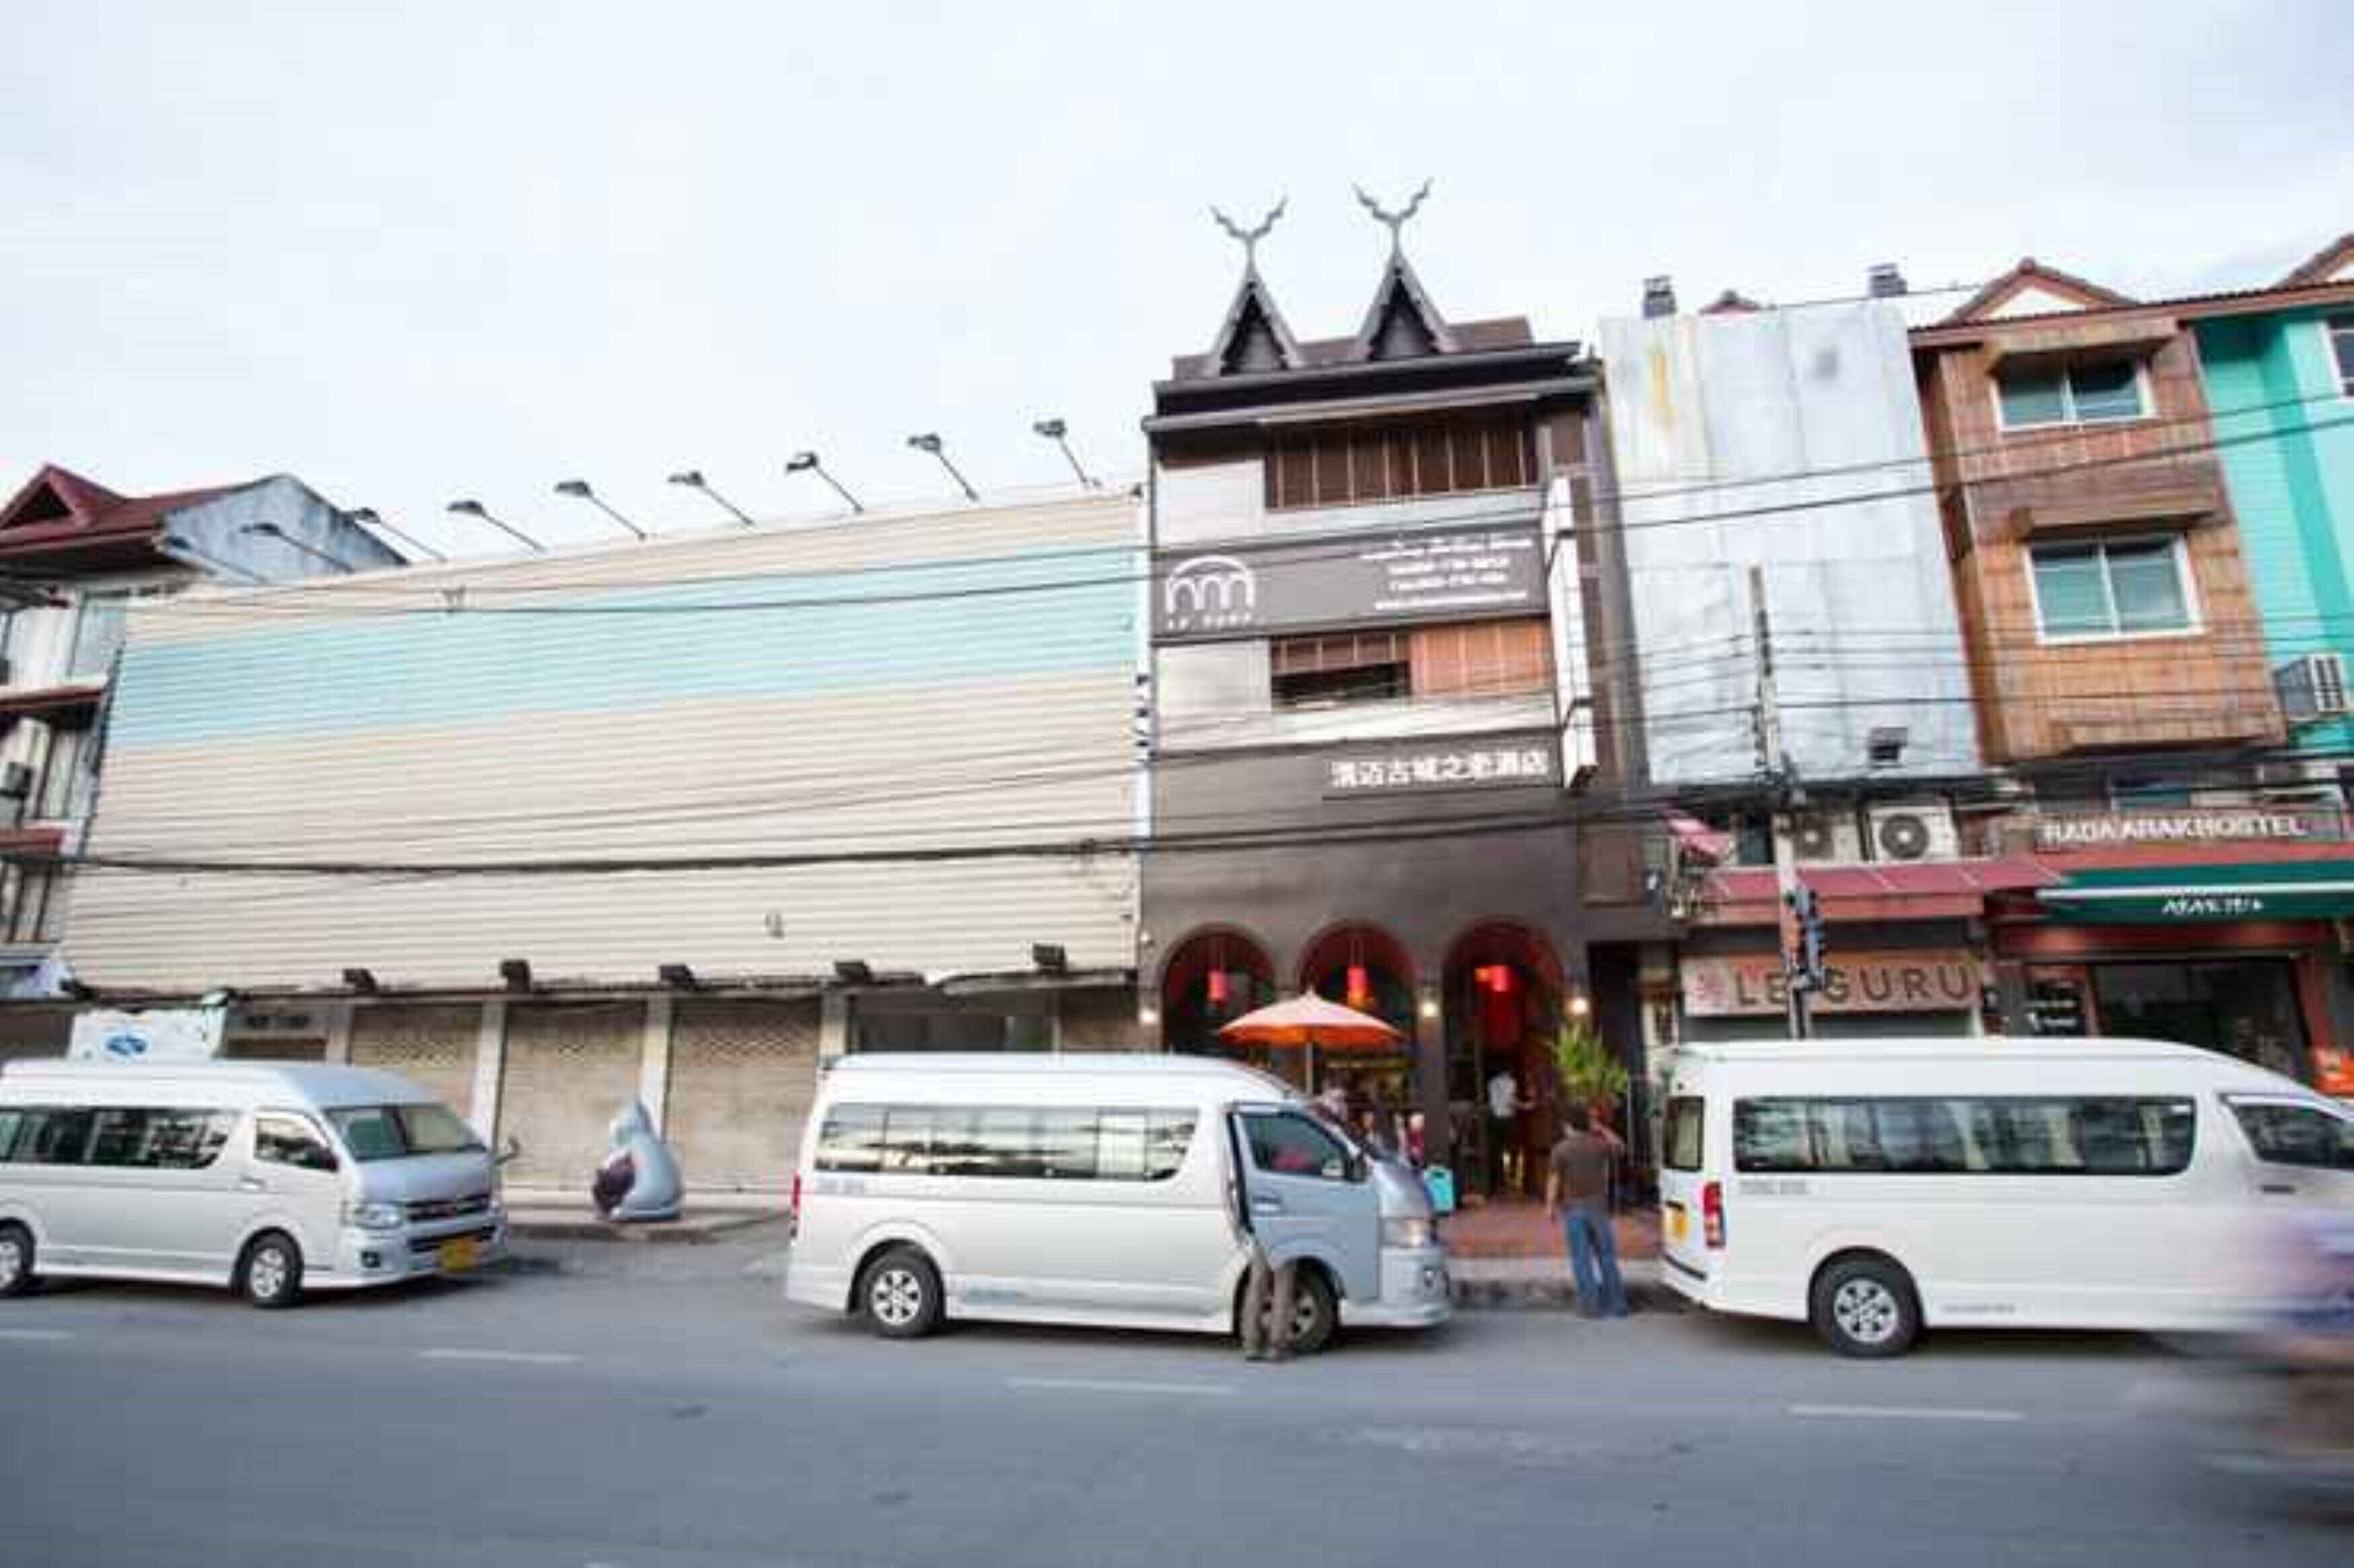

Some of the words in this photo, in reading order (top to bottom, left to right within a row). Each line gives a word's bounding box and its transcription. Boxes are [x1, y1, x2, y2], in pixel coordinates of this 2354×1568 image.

[2195, 812, 2310, 837] HOSTEL
[1735, 970, 1790, 1006] LE
[1824, 965, 1970, 1003] GURU
